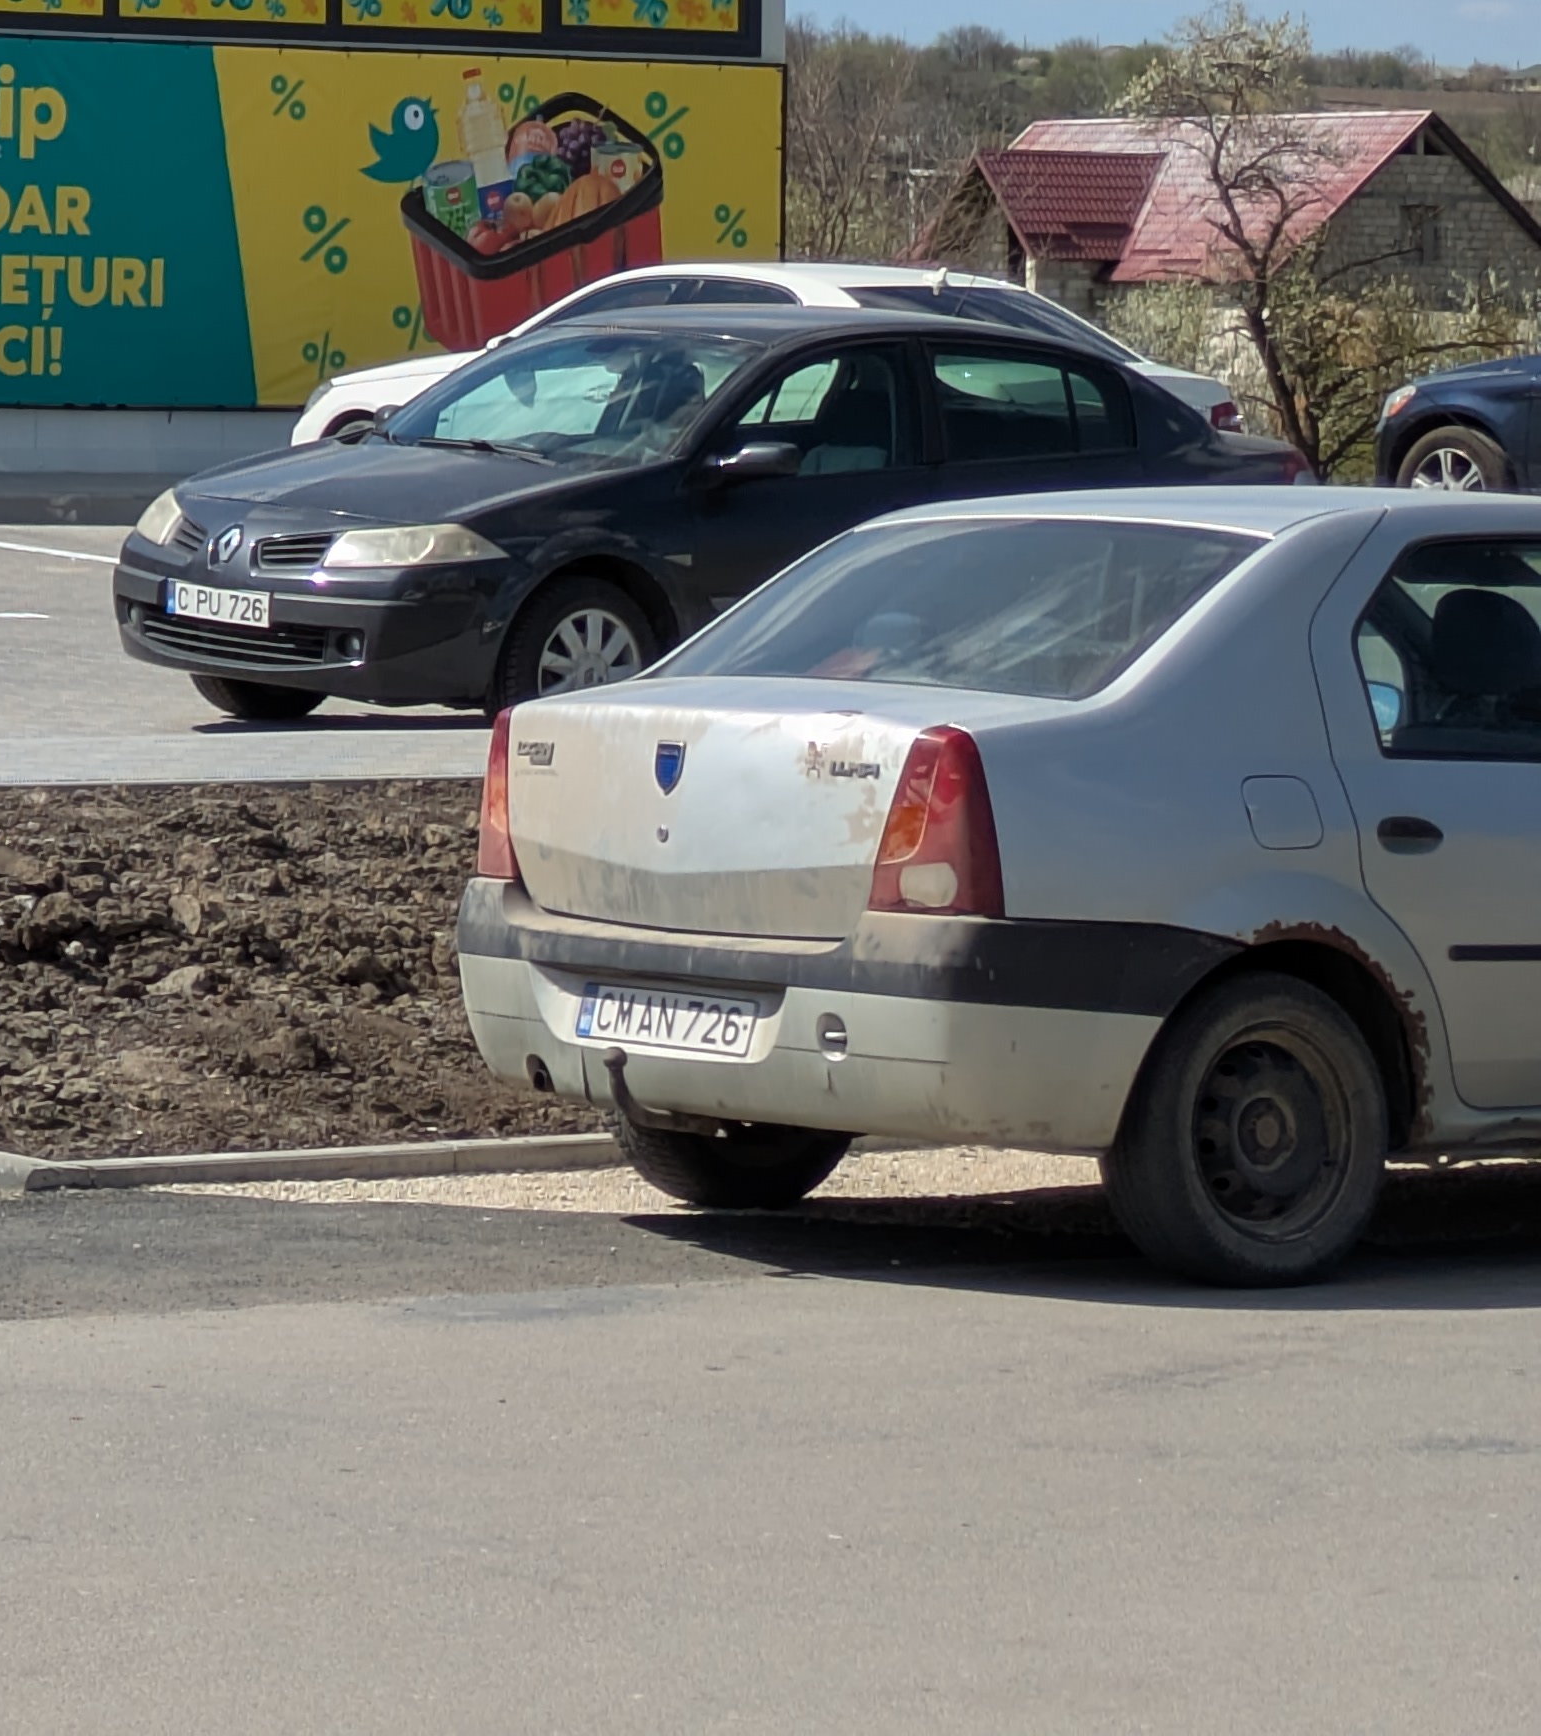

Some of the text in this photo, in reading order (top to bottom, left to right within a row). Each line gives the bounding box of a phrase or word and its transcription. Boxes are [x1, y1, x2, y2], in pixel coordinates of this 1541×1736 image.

[178, 586, 263, 623] C PU 726
[682, 1000, 743, 1047] 726
